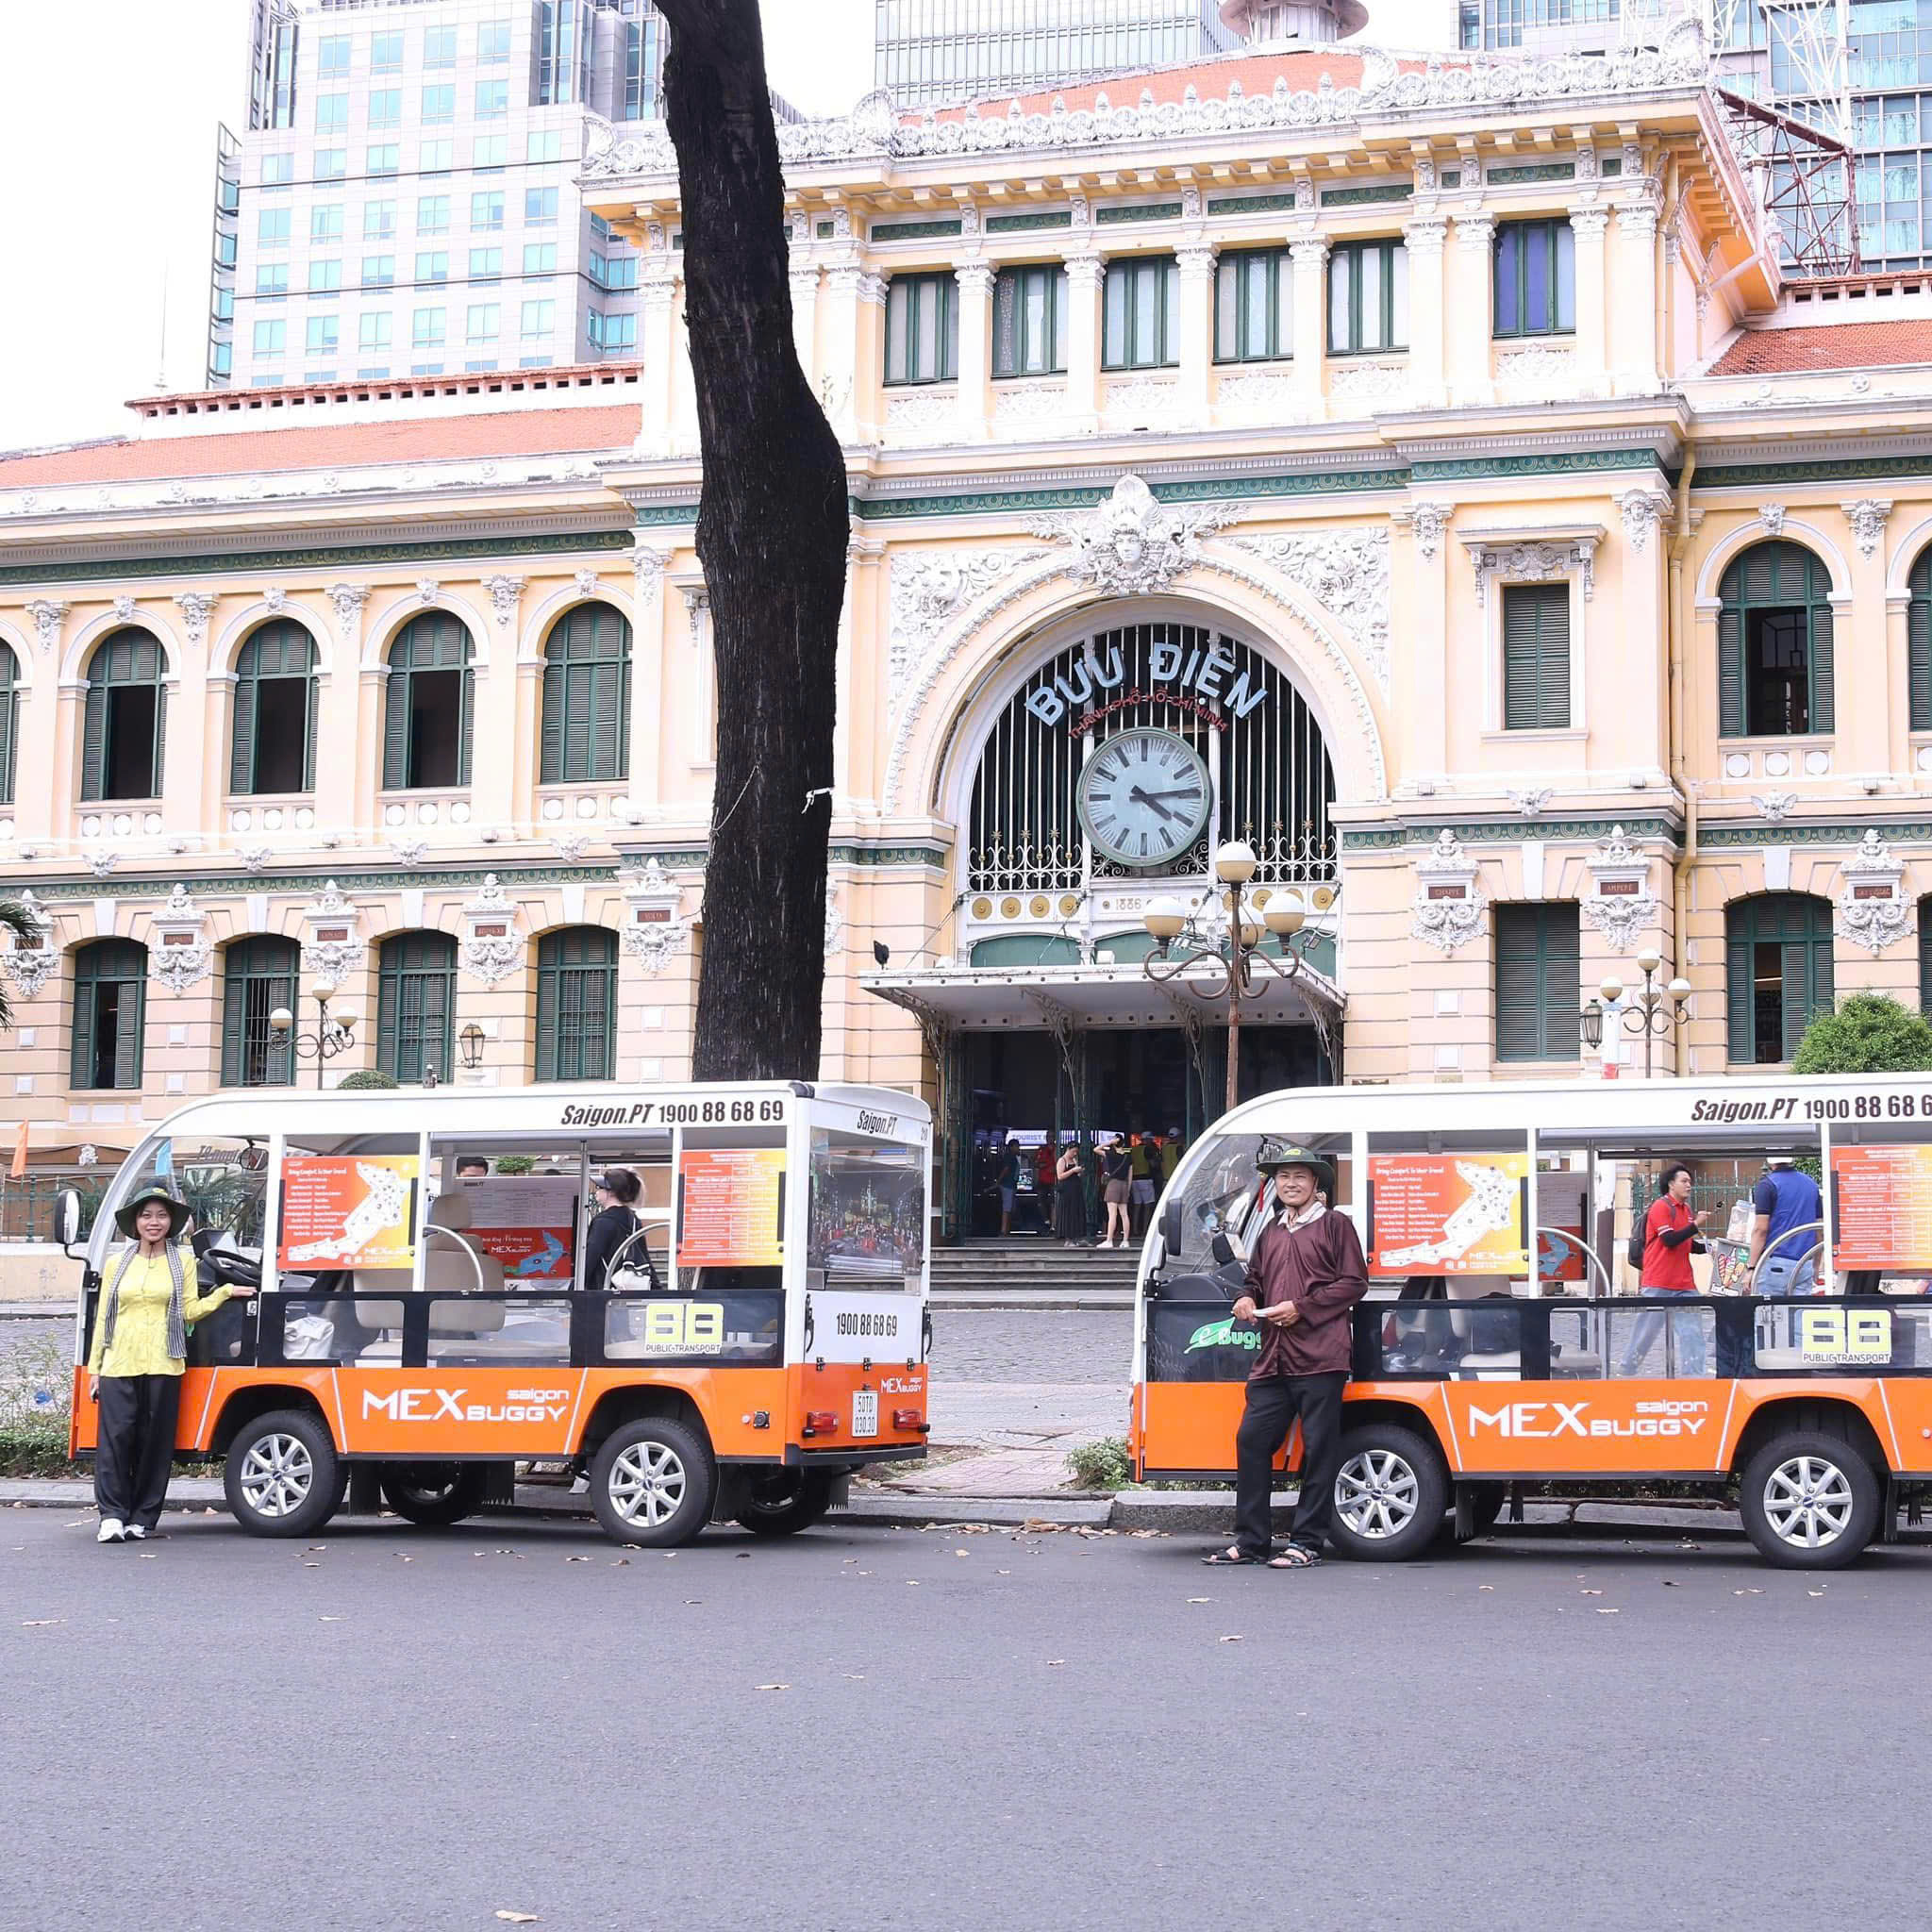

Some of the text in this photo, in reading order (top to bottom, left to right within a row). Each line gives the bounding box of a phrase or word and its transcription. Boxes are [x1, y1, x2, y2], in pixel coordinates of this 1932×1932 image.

[1149, 641, 1270, 719] ĐIỆN
[1195, 704, 1229, 733] MINH
[561, 1100, 784, 1126] Saigon.PT 1900 88 68 69
[1691, 1098, 1799, 1123] Saigon.PT
[1804, 1099, 1850, 1119] 1900
[1855, 1095, 1881, 1118] 88
[1888, 1094, 1915, 1117] 68
[857, 1109, 898, 1136] Saigon.PT
[837, 1313, 897, 1337] 1900 88 68 69
[507, 1387, 569, 1402] saigon
[881, 1377, 903, 1393] MEX
[362, 1389, 568, 1422] MEX BUGGY
[1636, 1399, 1708, 1415] saigon
[1469, 1403, 1707, 1438] MEX BUGGY
